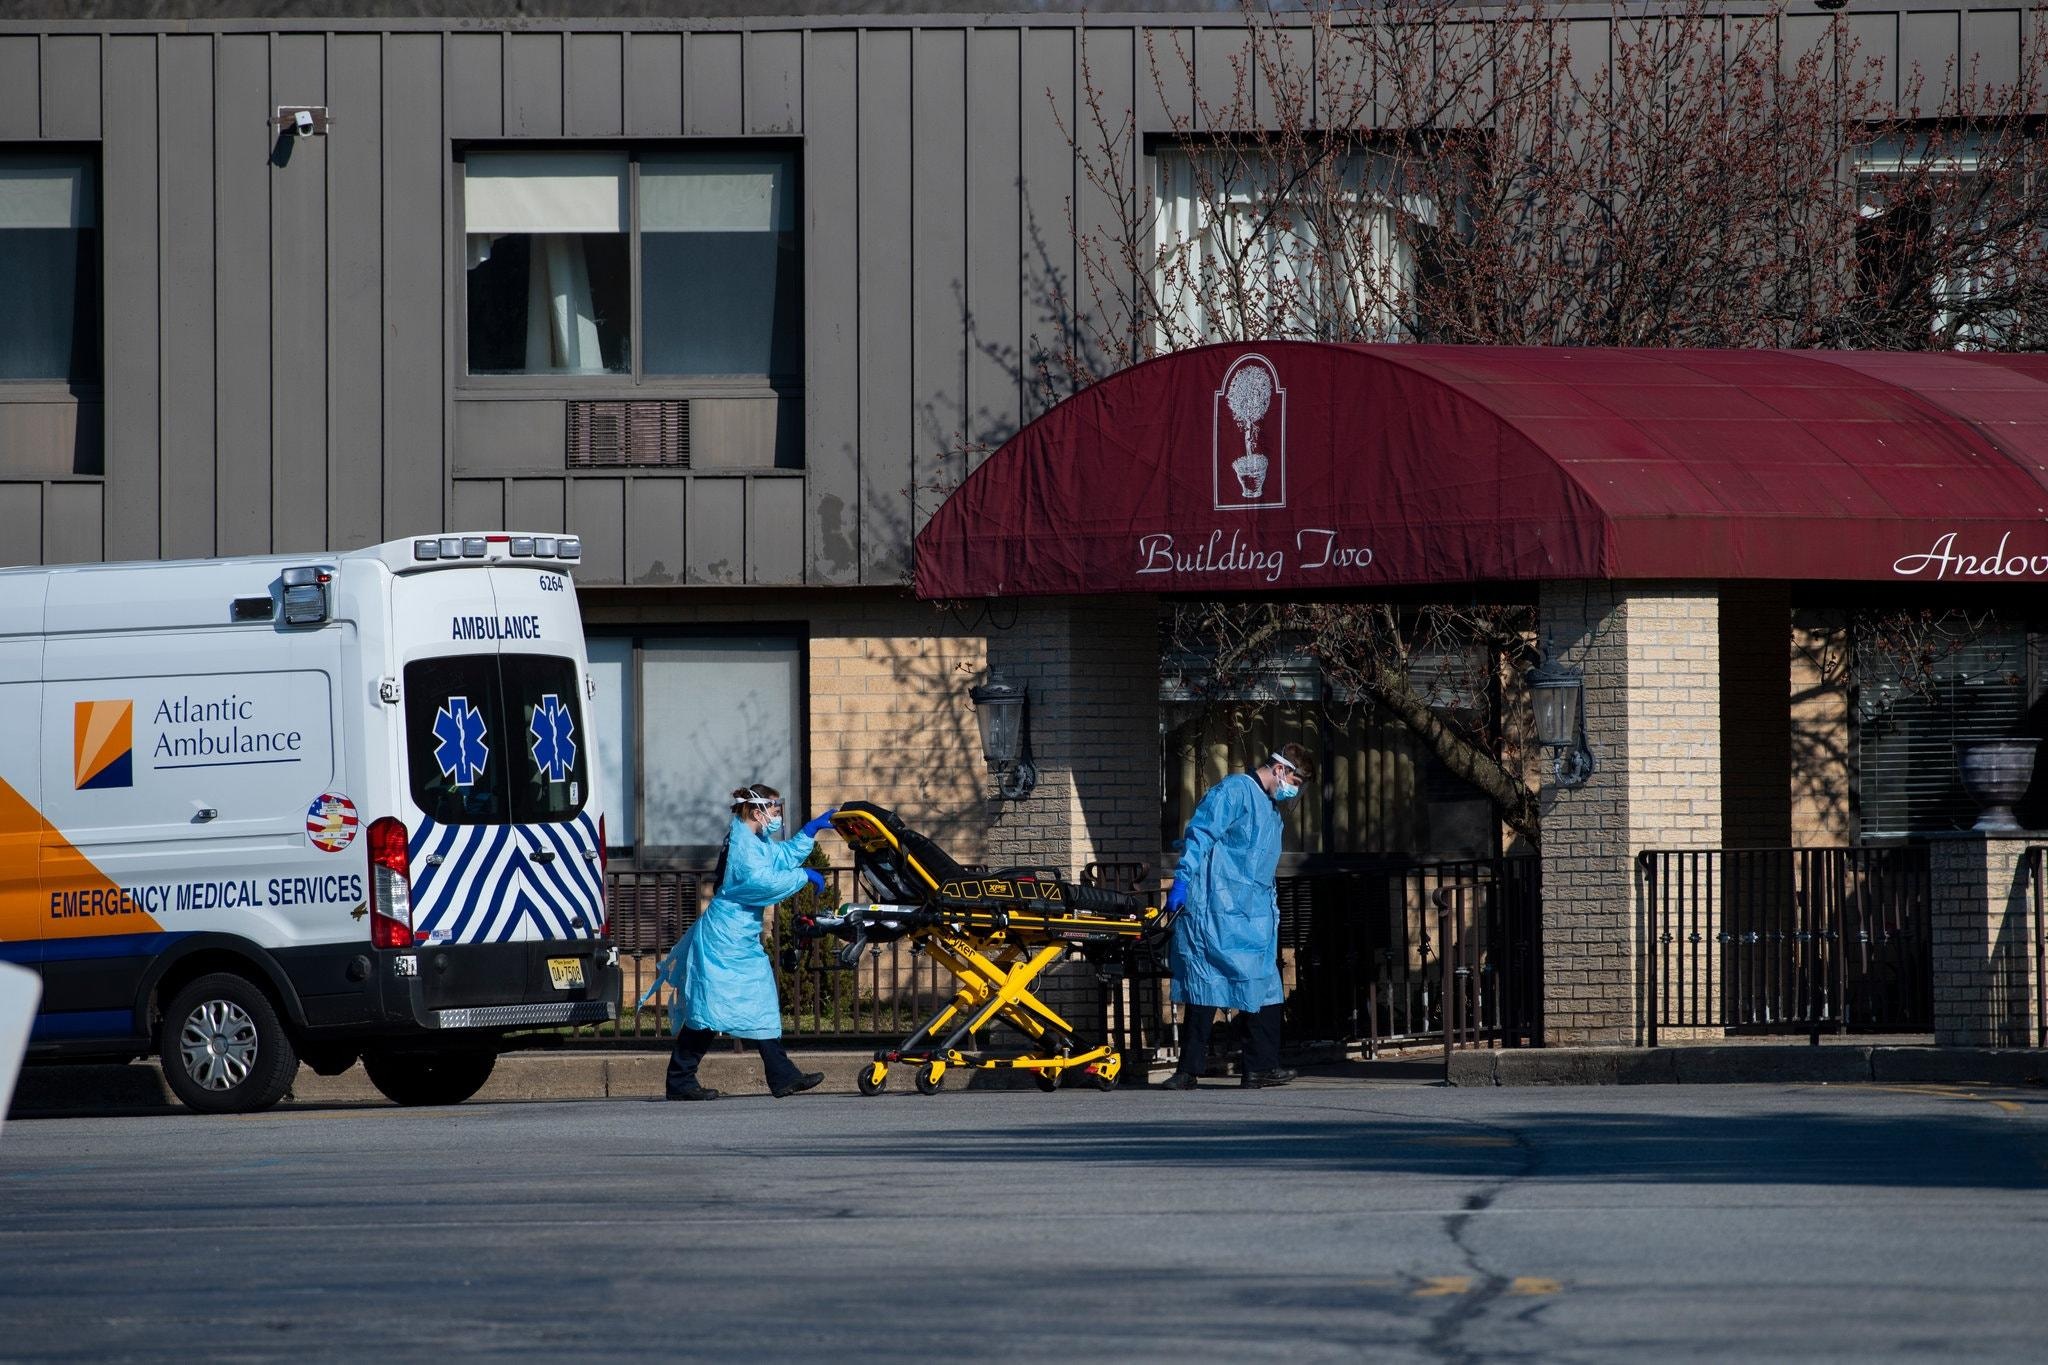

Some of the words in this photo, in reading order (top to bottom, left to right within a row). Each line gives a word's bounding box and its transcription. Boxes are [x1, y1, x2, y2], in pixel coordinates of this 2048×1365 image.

[1136, 529, 1284, 582] Building
[1297, 528, 1373, 569] Two
[540, 575, 563, 592] 6264
[452, 616, 541, 640] AMBULANCE
[154, 694, 253, 724] Atlantic
[154, 726, 301, 757] Ambulance
[51, 885, 171, 919] EMERGENCY
[176, 879, 263, 911] MEDICAL
[268, 874, 363, 907] SERVICES
